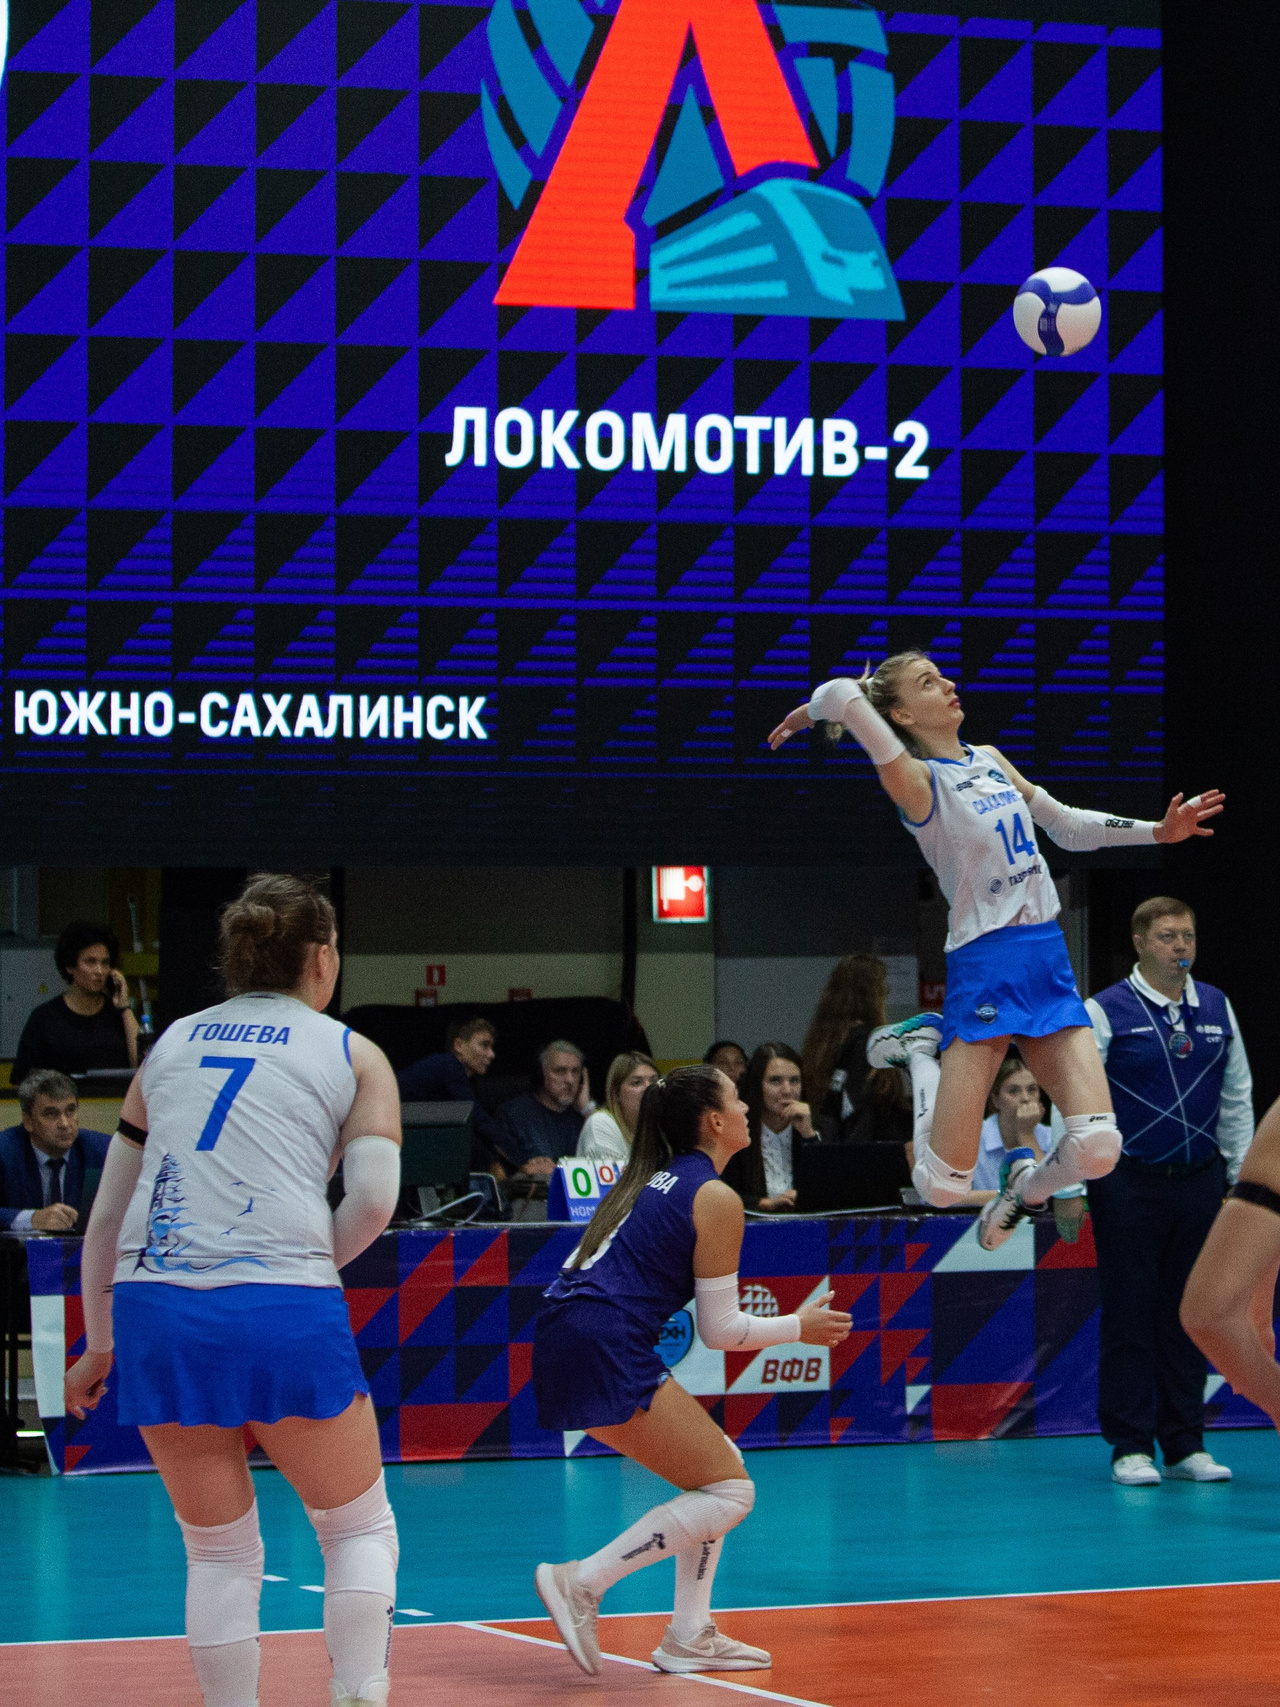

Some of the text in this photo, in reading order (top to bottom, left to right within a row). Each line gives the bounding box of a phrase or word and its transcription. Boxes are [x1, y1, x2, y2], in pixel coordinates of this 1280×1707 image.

[445, 406, 931, 480] ЛОКОМОТИВ-2
[13, 688, 489, 740] ЮЖНО-САХАЛИНСК
[994, 812, 1035, 866] 14
[187, 1023, 291, 1045] ГОШЕВА
[195, 1056, 256, 1151] 7
[571, 1167, 592, 1197] 0
[598, 1165, 614, 1183] 0
[570, 1206, 596, 1218] HOM
[761, 1357, 822, 1385] ВФВ
